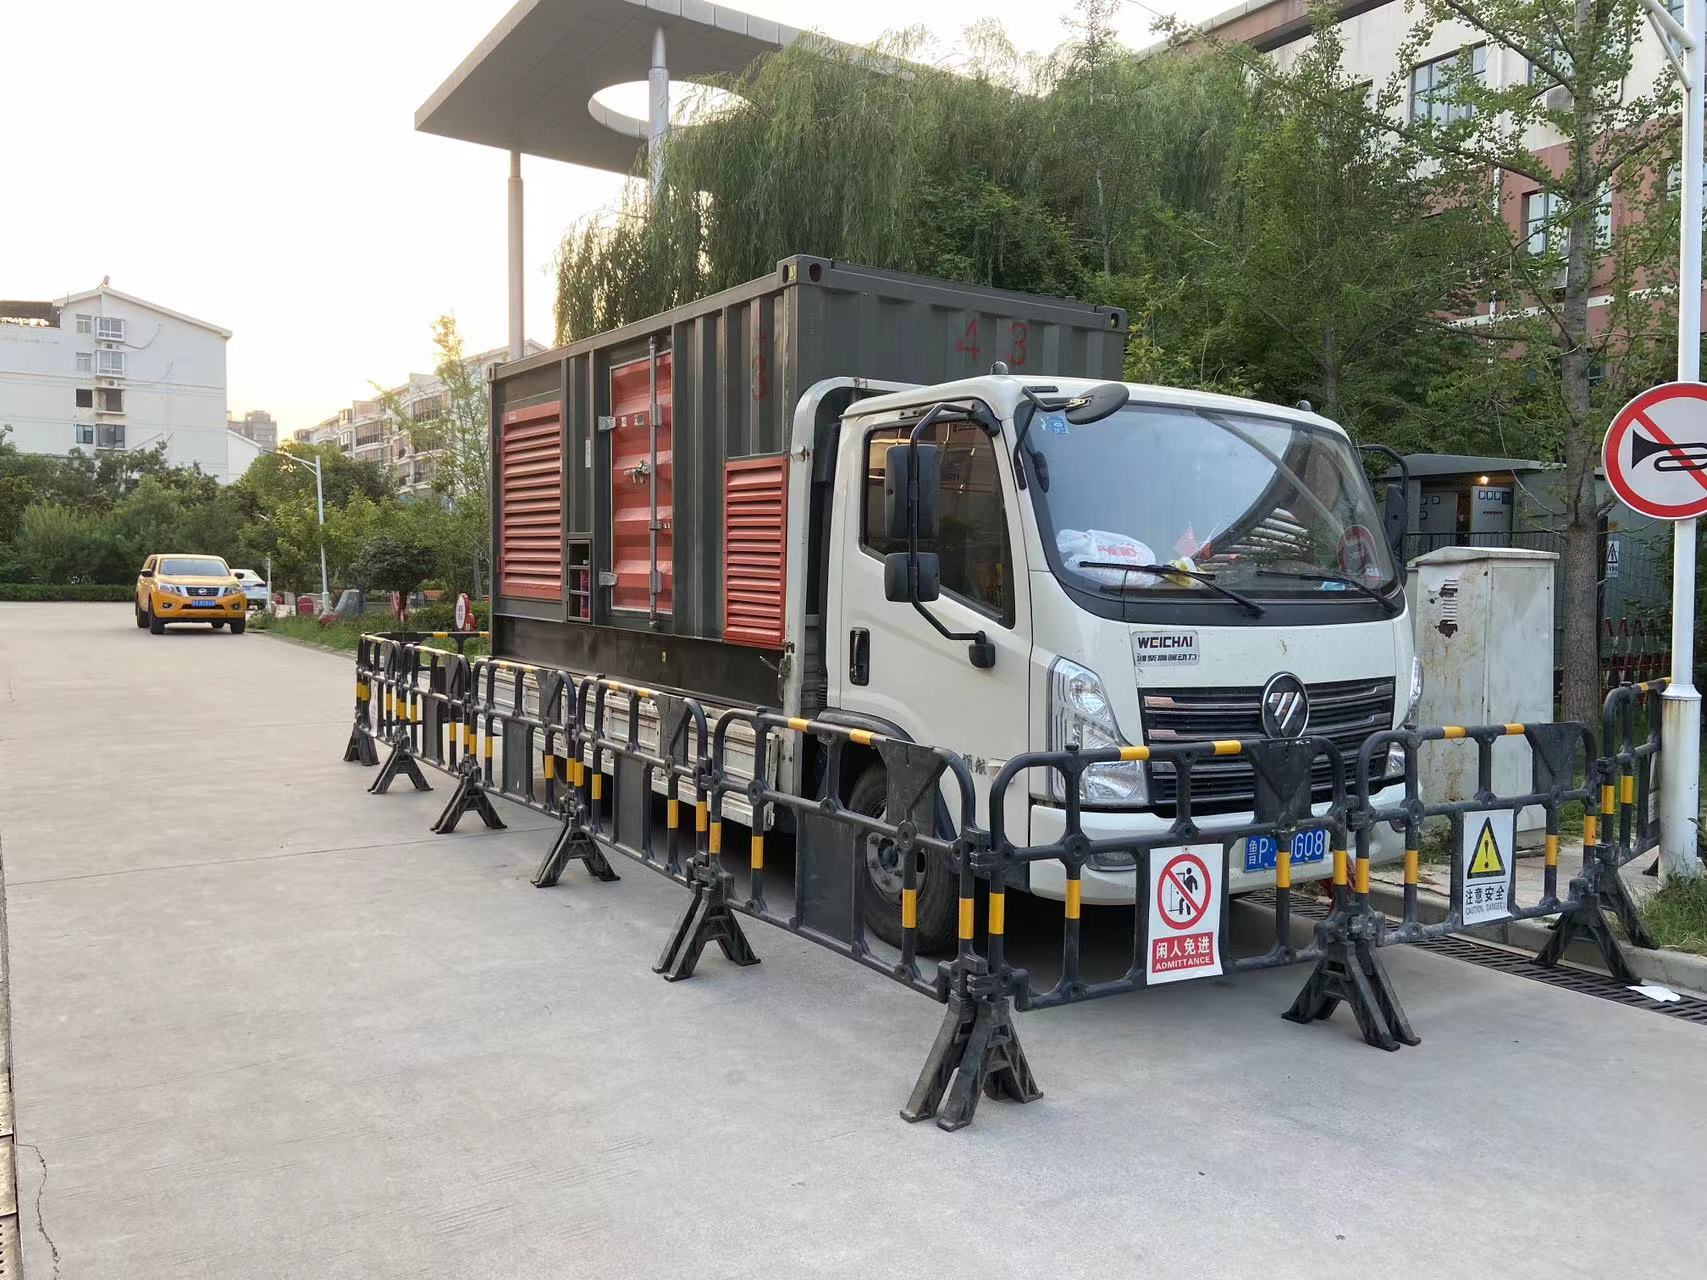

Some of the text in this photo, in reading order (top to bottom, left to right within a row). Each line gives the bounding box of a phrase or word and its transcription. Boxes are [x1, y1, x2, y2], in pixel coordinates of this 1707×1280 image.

[1137, 635, 1193, 649] WEICHAI
[1465, 885, 1505, 905] 注意安全
[1156, 935, 1210, 960] 闲人免进
[1155, 955, 1211, 971] ADMITTANCE
